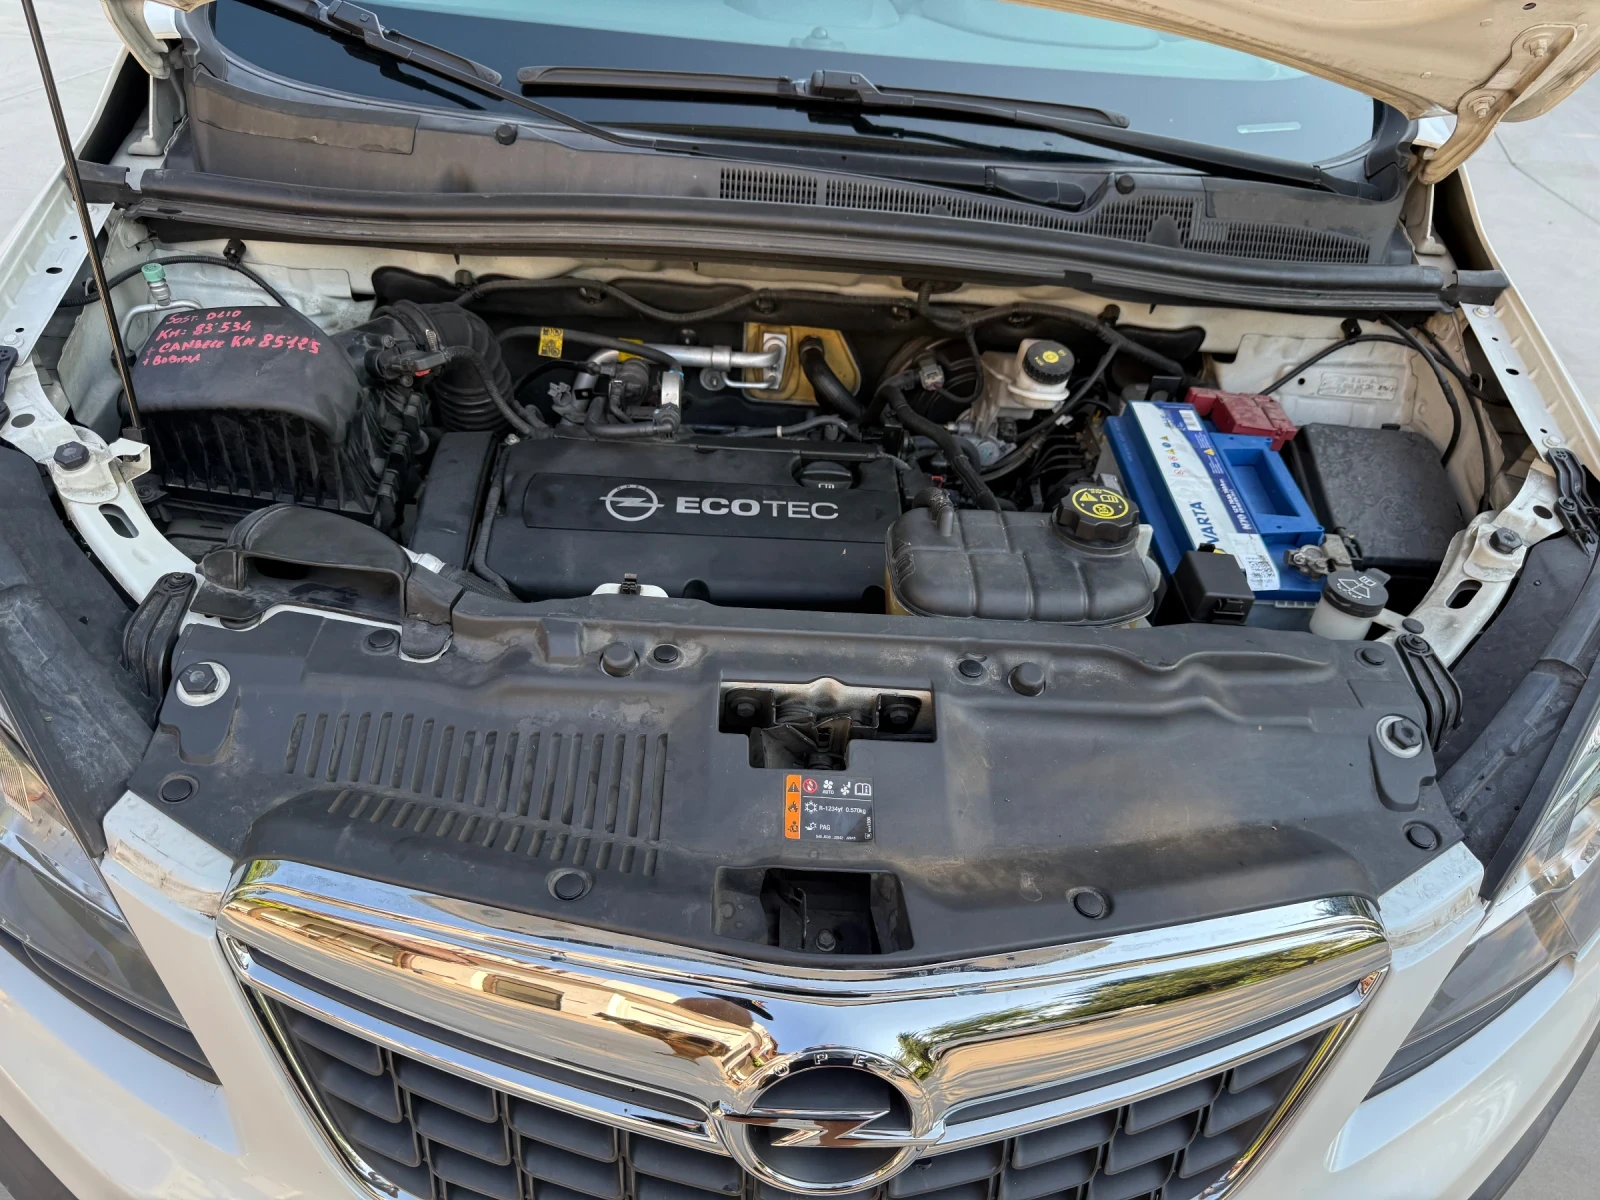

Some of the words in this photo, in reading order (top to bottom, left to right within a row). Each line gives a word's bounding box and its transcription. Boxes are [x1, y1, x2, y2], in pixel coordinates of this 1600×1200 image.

[676, 496, 839, 520] ECOTEC
[1189, 501, 1221, 545] VARTA
[818, 805, 843, 813] R-1234yf
[845, 806, 867, 815] 0.570kg
[819, 823, 831, 831] PAG
